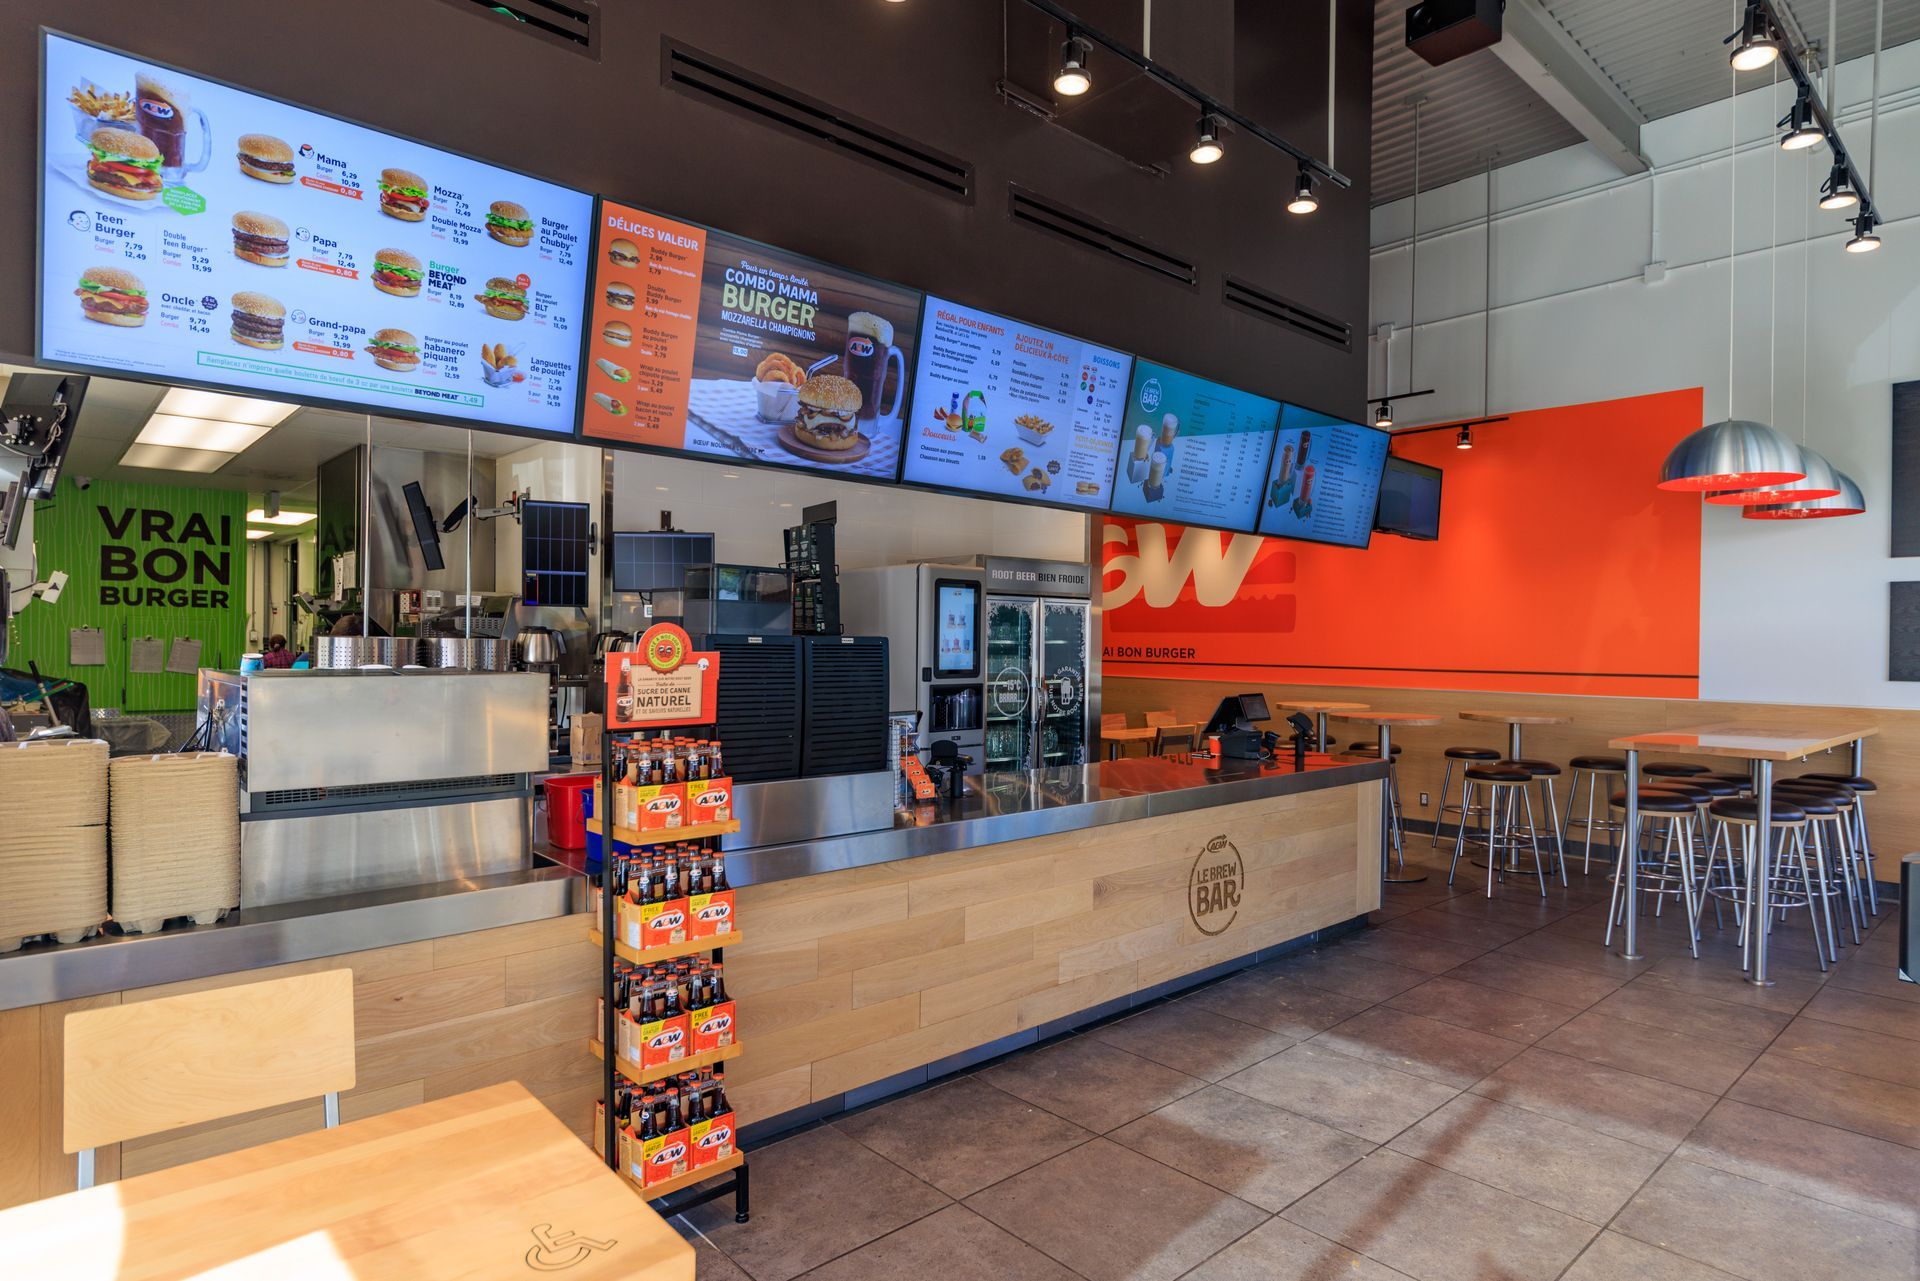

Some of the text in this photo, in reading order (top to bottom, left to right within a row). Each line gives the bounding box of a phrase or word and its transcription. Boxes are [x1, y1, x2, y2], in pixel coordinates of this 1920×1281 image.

[142, 101, 173, 116] A&W
[317, 153, 347, 168] Mama
[316, 164, 333, 173] Burger
[434, 185, 462, 200] Mozza
[95, 212, 123, 225] Teen
[432, 215, 482, 234] Double Mozza
[541, 217, 569, 231] Burger
[95, 223, 136, 238] Burger
[163, 229, 187, 241] Double
[540, 227, 578, 243] au Poulet
[608, 215, 699, 251] DÉLICES VALEUR
[95, 235, 115, 246] Burger
[125, 242, 143, 250] 7,79
[163, 238, 204, 253] Teen Burger
[312, 235, 338, 248] Papa
[540, 236, 570, 251] Chubby
[125, 250, 147, 260] 12,49
[162, 249, 182, 259] Burger
[312, 246, 329, 255] Burger
[651, 246, 687, 261] Buddy Burger
[429, 260, 460, 274] Burger
[740, 260, 809, 288] Pour un temps limité
[428, 269, 467, 285] BEYOND
[428, 278, 453, 291] MEAT
[725, 268, 776, 294] COMBO
[778, 282, 818, 305] MAMA
[162, 293, 195, 306] Oncle
[535, 291, 552, 299] Burger
[542, 297, 558, 306] poulet
[535, 303, 549, 312] BLT
[722, 283, 816, 329] BURGER
[160, 312, 179, 320] Burger
[937, 310, 958, 323] RÉGAL
[959, 316, 977, 329] POUR
[977, 321, 1005, 336] ENFANTS
[308, 317, 366, 335] Grand-papa
[308, 328, 325, 337] Burger
[721, 310, 816, 342] MOZZARELLA CHAMPIGNONS
[934, 334, 946, 342] Buddy
[1016, 333, 1054, 350] AJOUTEZ UN
[424, 342, 466, 356] habanero
[850, 343, 874, 355] A&W
[1014, 343, 1047, 358] DÉLICIEUX
[423, 351, 458, 364] piquant
[530, 357, 572, 371] Languettes
[1093, 355, 1120, 369] BOISSONS
[541, 367, 566, 377] poulet
[414, 388, 441, 398] BEYOND
[441, 391, 459, 401] MEAT
[1142, 392, 1160, 407] BAR
[920, 444, 940, 453] Chausson
[919, 453, 938, 462] Chausson
[97, 505, 231, 546] VRAI
[101, 545, 230, 585] BON
[1103, 523, 1265, 611] &W
[991, 569, 1085, 585] ROOT BEER BIEN FROIDE
[100, 586, 229, 608] BURGER
[1102, 646, 1195, 659] AI BON BURGER
[636, 695, 691, 708] NATUREL
[1050, 699, 1066, 716] NOTRE
[1066, 701, 1080, 716] ROOT
[649, 798, 679, 811] A&W
[699, 794, 726, 806] A&W
[1210, 839, 1228, 851] A&W
[1197, 862, 1237, 884] LE BREW
[1196, 879, 1241, 917] BAR
[700, 906, 728, 919] A&W
[653, 915, 682, 929] A&W
[694, 1011, 708, 1019] FREE
[702, 1017, 730, 1033] A&W
[652, 1031, 682, 1048] A&W
[701, 1130, 728, 1147] A&W
[655, 1146, 684, 1164] A&W
